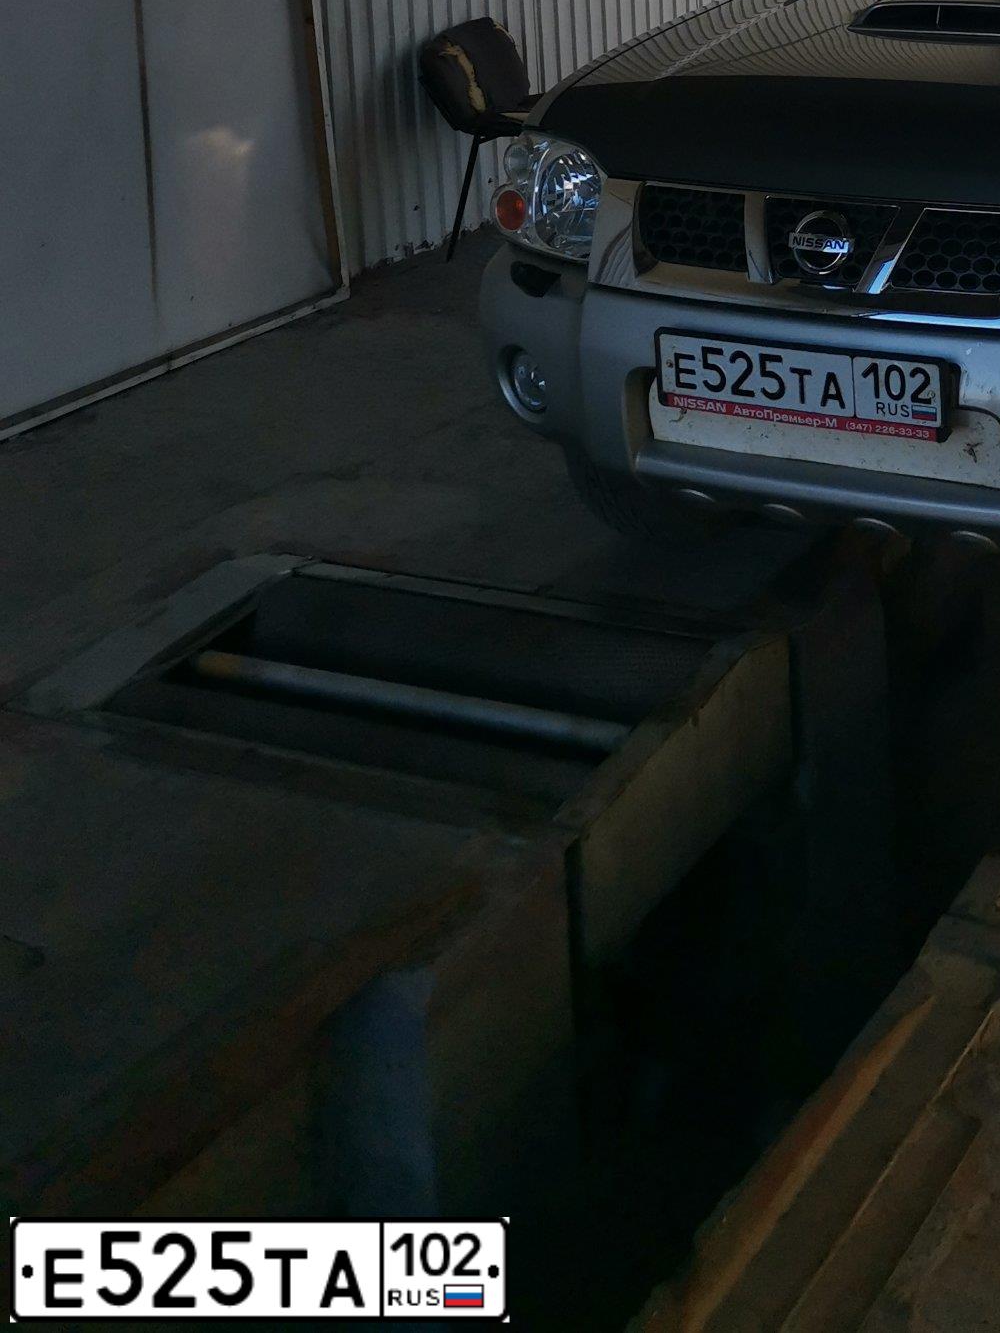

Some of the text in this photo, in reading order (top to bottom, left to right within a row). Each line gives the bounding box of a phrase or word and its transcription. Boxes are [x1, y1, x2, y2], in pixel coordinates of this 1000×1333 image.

[792, 235, 846, 250] NISSAN
[861, 361, 933, 405] 102
[672, 395, 727, 414] NISSAN
[845, 421, 873, 433] (347)
[875, 401, 910, 418] RUS
